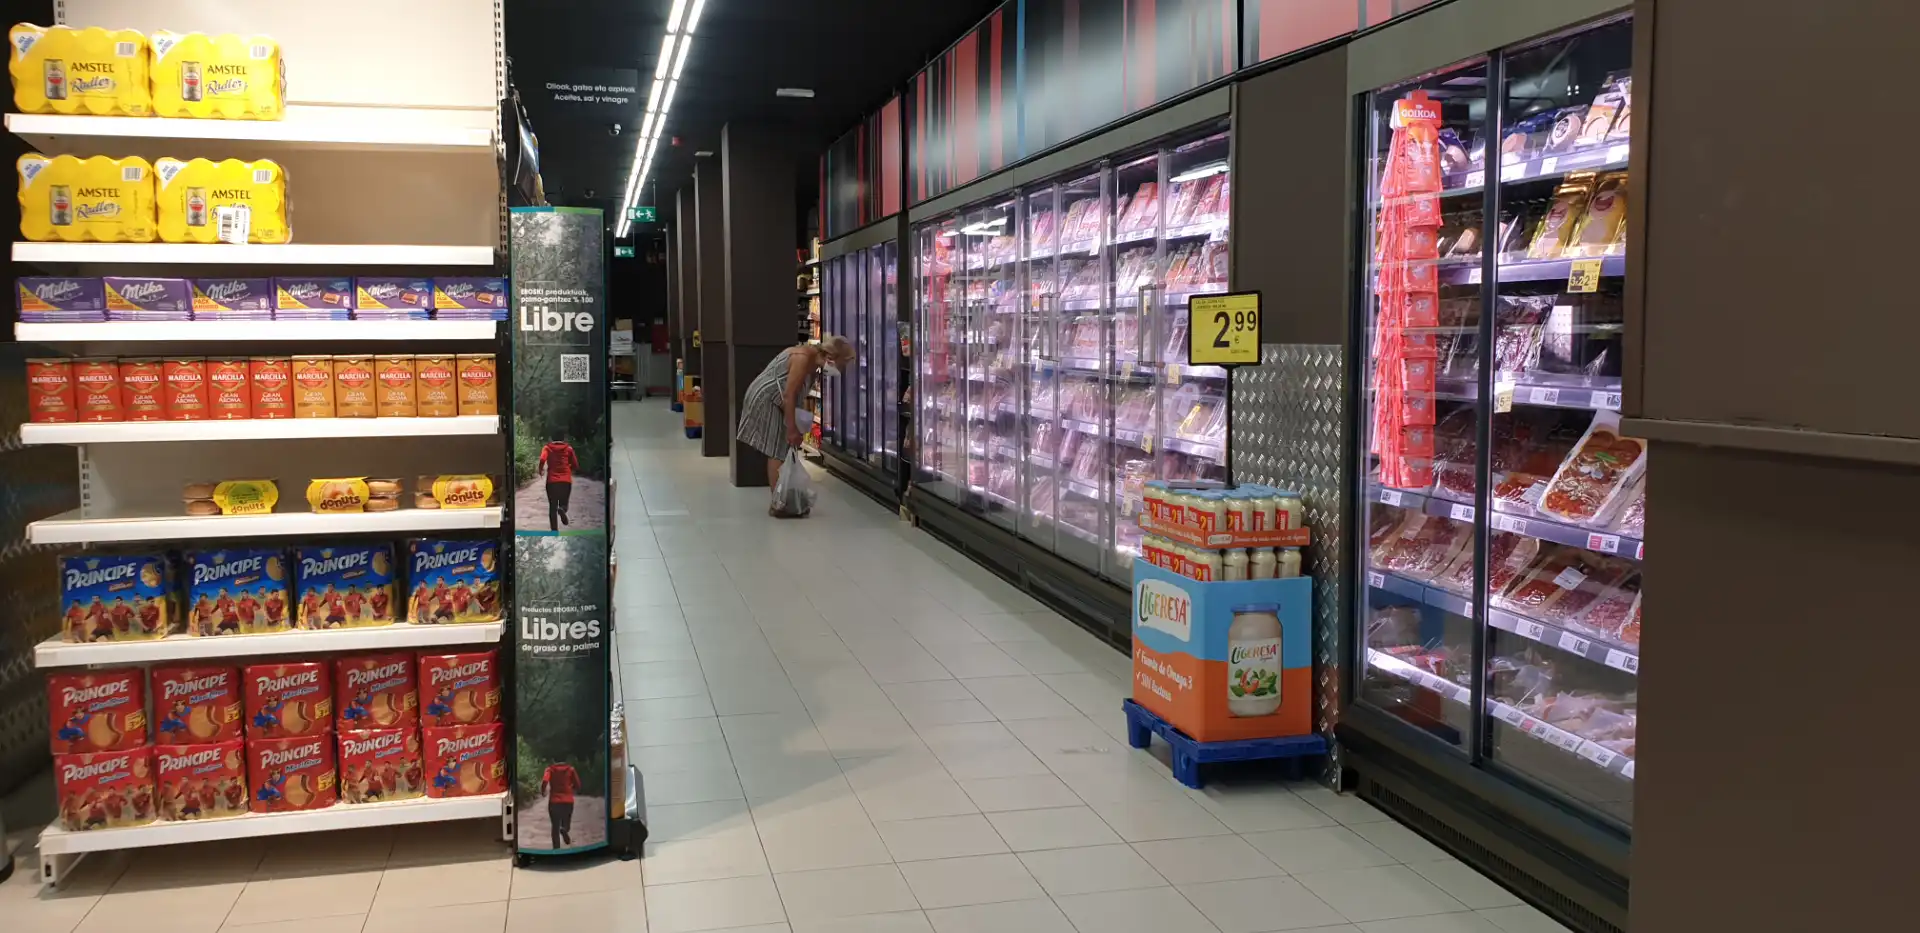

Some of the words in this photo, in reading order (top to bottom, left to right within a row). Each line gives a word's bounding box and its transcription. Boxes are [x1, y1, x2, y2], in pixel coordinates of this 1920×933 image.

[71, 62, 115, 73] AMSTEL
[207, 64, 247, 75] AMSTEL
[71, 76, 115, 92] Radler
[206, 79, 247, 95] Radler
[602, 96, 629, 104] vinagre
[76, 188, 120, 198] AMSTEL
[211, 190, 252, 200] AMSTEL
[76, 201, 121, 218] Radler
[36, 280, 81, 299] Milka
[121, 281, 164, 300] Milka
[206, 279, 248, 299] Milka
[288, 282, 319, 296] Milka
[368, 282, 398, 296] Milka
[545, 288, 589, 296] produktuak,
[520, 306, 594, 332] Libre
[320, 495, 361, 510] donuts
[444, 489, 484, 504] donuts
[231, 503, 266, 514] donuts
[194, 556, 262, 586] PRINCIPE
[301, 550, 369, 580] PRINCIPE
[415, 547, 479, 573] PRINCIPE
[65, 562, 137, 591] PRINCIPE
[1139, 583, 1187, 626] LIGERESA
[522, 616, 600, 641] Libres
[522, 643, 532, 651] de
[533, 645, 557, 653] grasa
[572, 642, 600, 652] palma
[256, 669, 318, 696] PRINCIPE
[346, 660, 407, 688] PRINCIPE
[430, 659, 489, 686] PRINCIPE
[1166, 664, 1188, 692] Omega
[1187, 675, 1193, 690] 3
[62, 678, 130, 707] PRINCIPE
[163, 672, 228, 700] PRINCIPE
[342, 731, 403, 759] PRINCIPE
[437, 729, 495, 757] PRINCIPE
[158, 747, 222, 775] PRINCIPE
[260, 741, 322, 770] PRINCIPE
[62, 755, 130, 784] PRINCIPE
